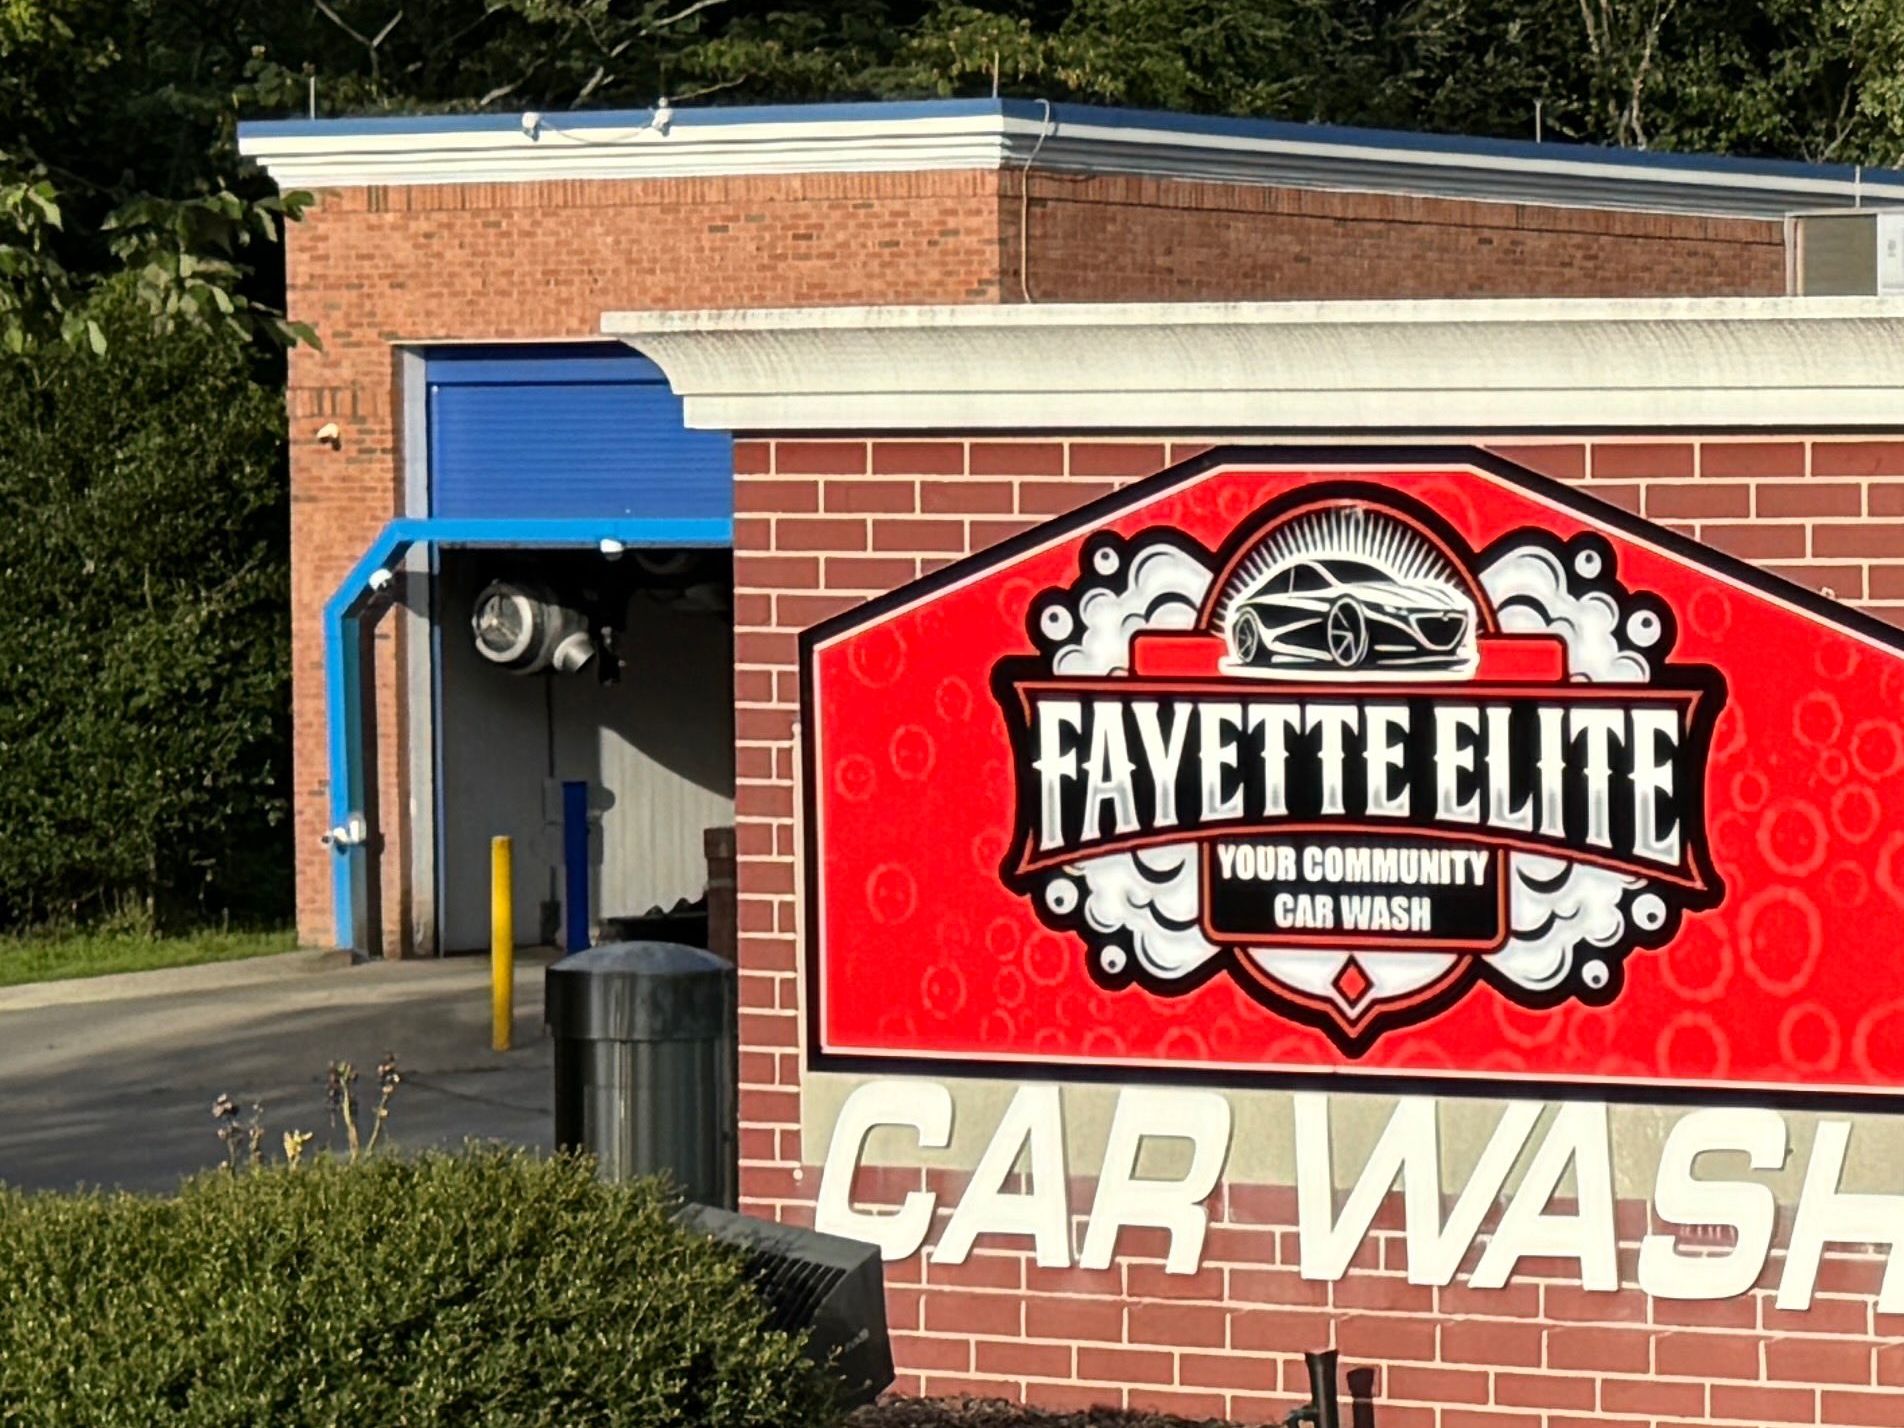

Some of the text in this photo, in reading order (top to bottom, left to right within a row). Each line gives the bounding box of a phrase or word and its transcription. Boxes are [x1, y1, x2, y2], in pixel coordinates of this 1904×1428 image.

[1034, 699, 1681, 866] FAYETTE ELITE
[1217, 844, 1490, 886] YOUR COMMUNITY
[1274, 893, 1432, 931] CAR WASH
[816, 1080, 1234, 1276] CAR
